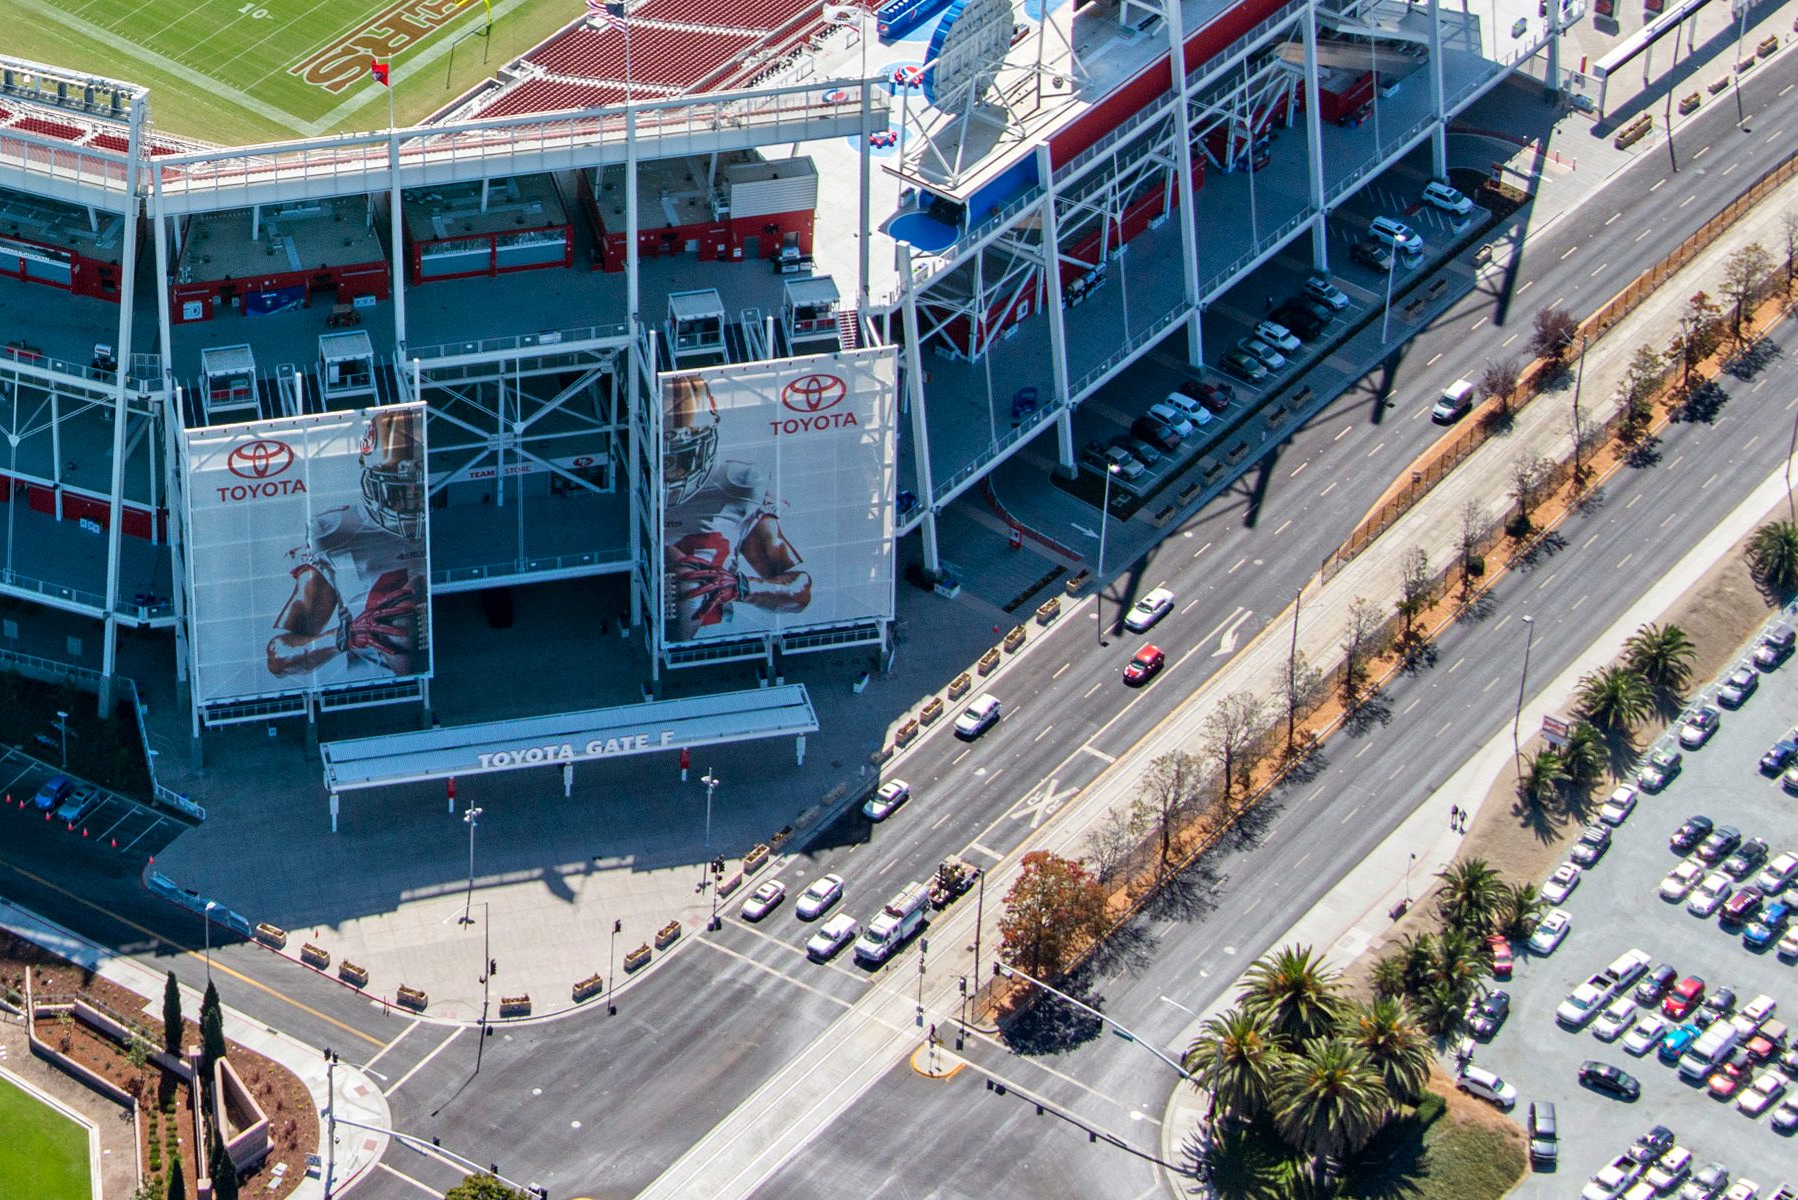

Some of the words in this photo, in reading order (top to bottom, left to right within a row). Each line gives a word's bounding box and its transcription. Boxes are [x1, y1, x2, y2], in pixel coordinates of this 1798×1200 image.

[237, 2, 268, 19] 10
[769, 412, 858, 436] TOYOTA
[469, 469, 495, 479] TEAM
[504, 466, 531, 476] STORE
[217, 478, 307, 503] TOYOTA
[478, 743, 575, 769] TOYOTA
[585, 733, 649, 756] GATE
[660, 731, 675, 746] F
